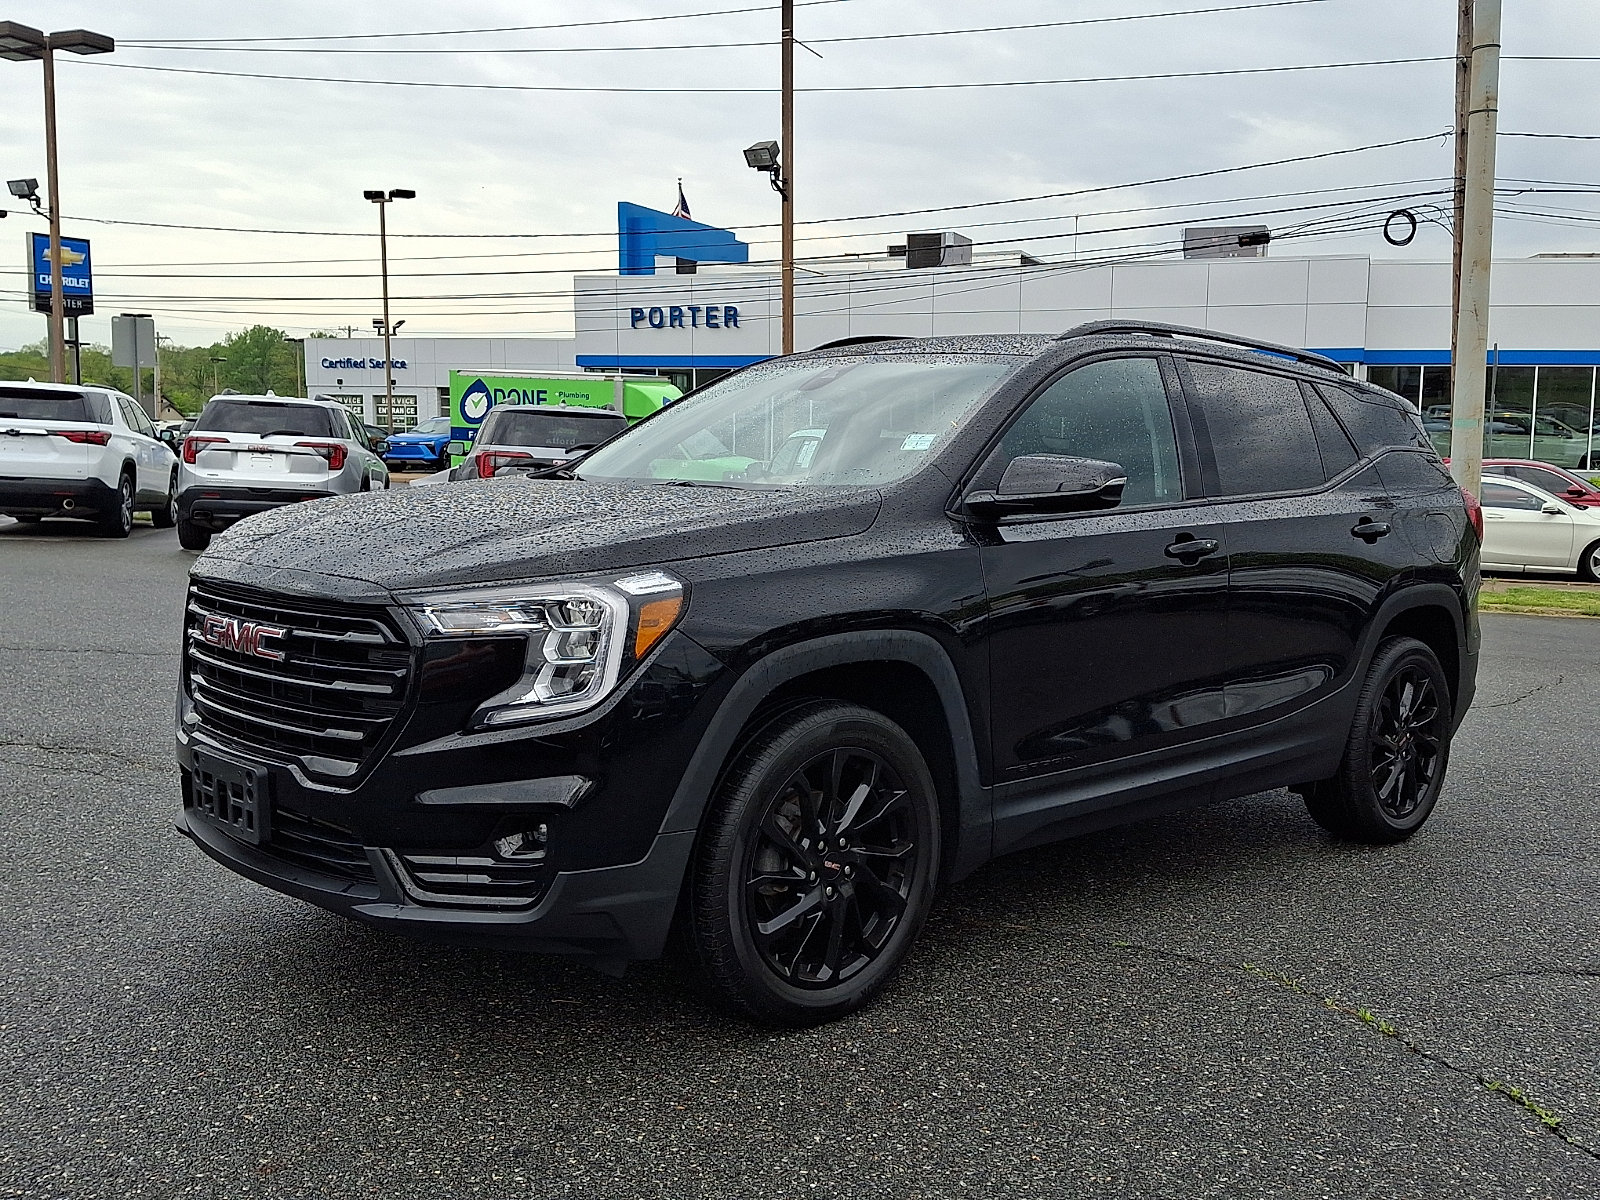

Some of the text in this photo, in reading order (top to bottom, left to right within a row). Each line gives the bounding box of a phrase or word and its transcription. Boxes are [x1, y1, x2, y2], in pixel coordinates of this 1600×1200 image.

[630, 306, 741, 329] PORTER
[322, 358, 408, 370] Certified Serice
[558, 391, 590, 400] Plumbing
[204, 615, 286, 661] GMC
